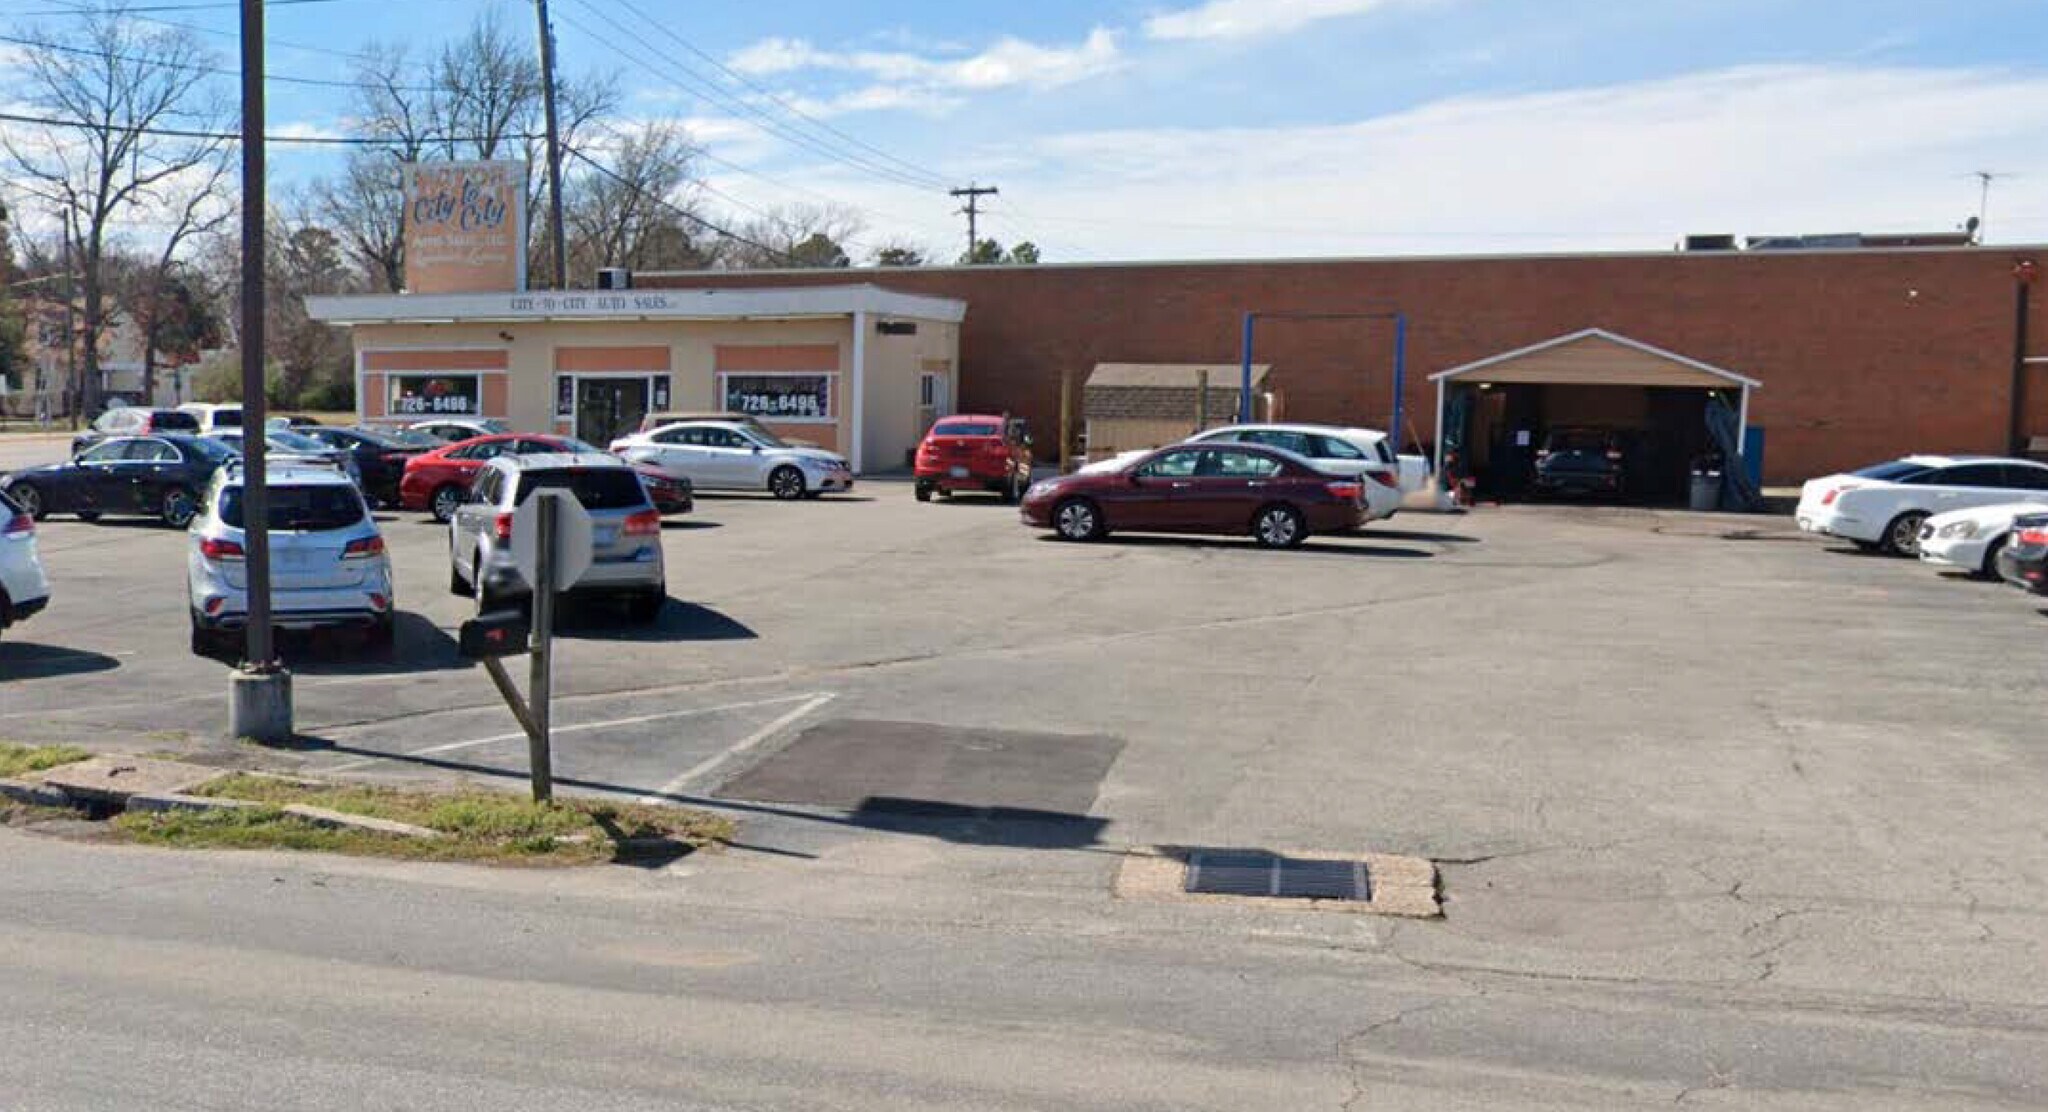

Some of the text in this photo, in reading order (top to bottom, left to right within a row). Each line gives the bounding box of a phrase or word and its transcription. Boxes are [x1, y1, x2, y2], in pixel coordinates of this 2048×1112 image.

[461, 176, 480, 207] to
[413, 192, 456, 226] City
[460, 196, 506, 232] City
